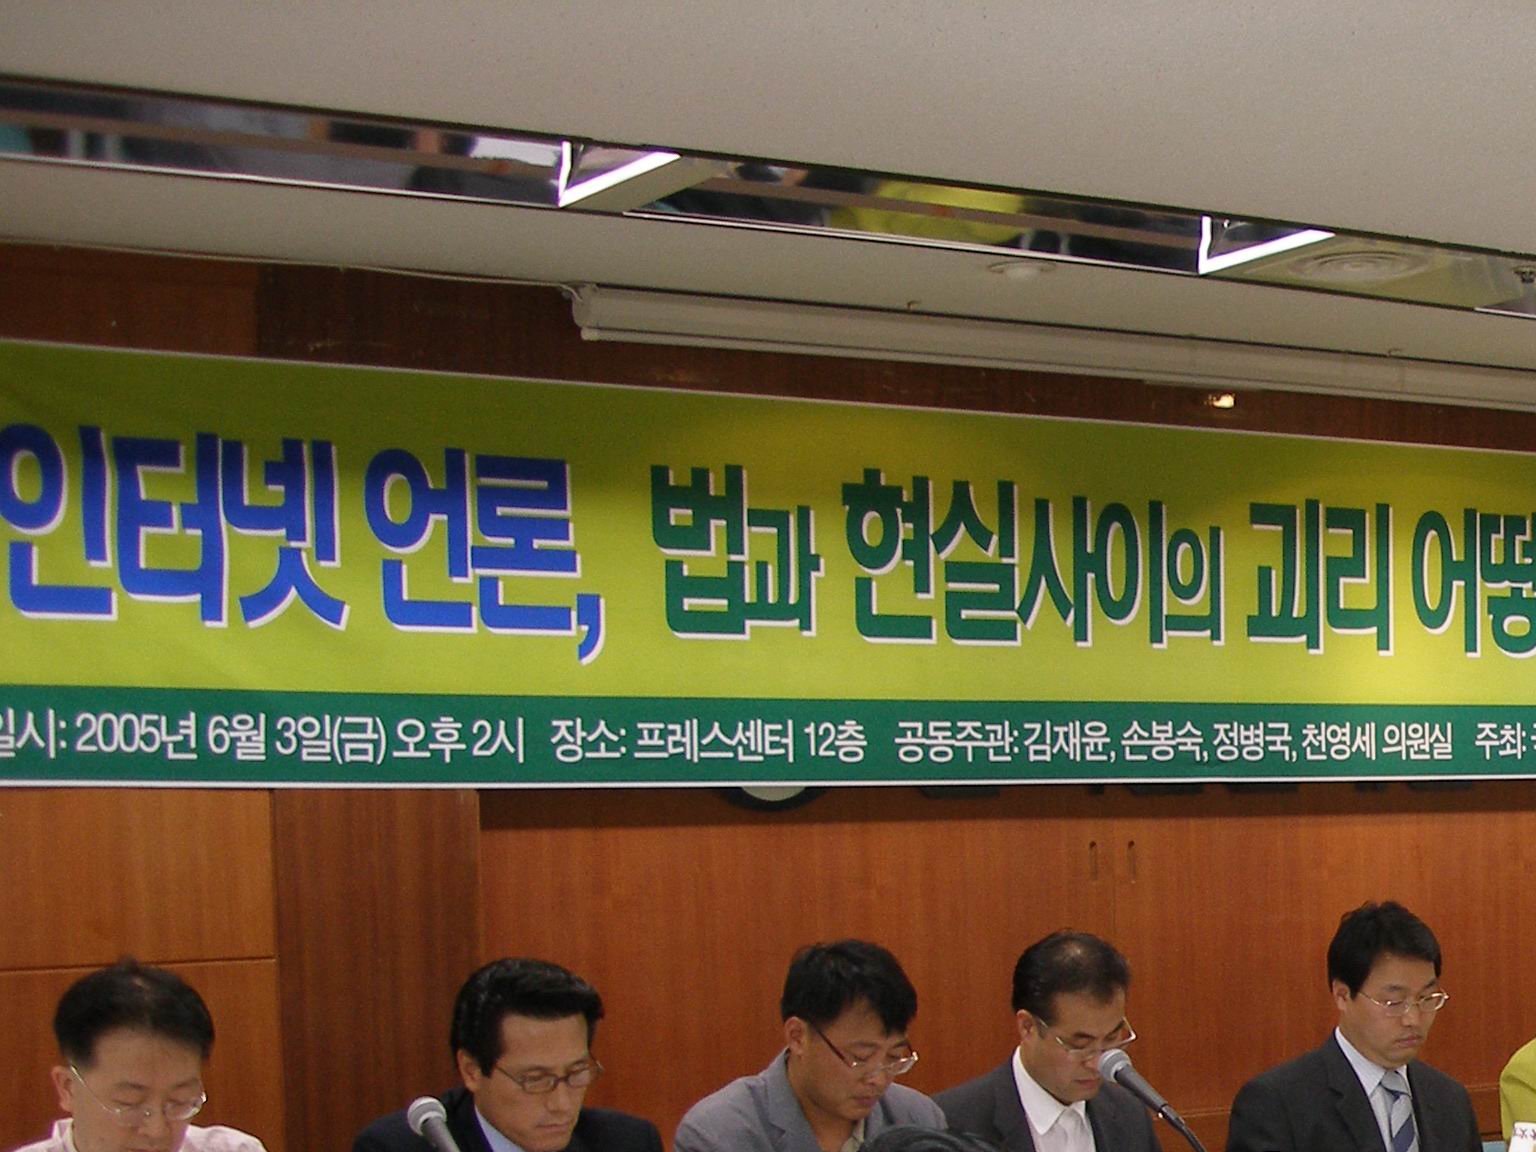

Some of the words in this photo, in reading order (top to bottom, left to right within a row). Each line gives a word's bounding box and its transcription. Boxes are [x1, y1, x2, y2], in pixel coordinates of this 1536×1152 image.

[0, 423, 347, 628] 인터넷
[365, 447, 604, 665] 언론,
[651, 464, 824, 640] 법과
[1247, 499, 1394, 656] 괴리
[75, 711, 197, 760] 2005년
[208, 713, 267, 761] 6월
[275, 715, 387, 764] 3일(금)
[392, 716, 466, 763] 오후
[472, 717, 524, 763] 2시
[550, 717, 627, 763] 장소:
[634, 718, 794, 763] 프레스센터
[803, 720, 867, 763] 12층
[894, 721, 1019, 762] 공동주관:
[1023, 721, 1116, 763] 김재윤,
[1120, 721, 1209, 764] 손봉숙,
[1212, 721, 1297, 763] 정병국,
[1301, 722, 1376, 760] 천영세
[1382, 722, 1452, 760] 의원실
[1475, 722, 1526, 760] 주최:
